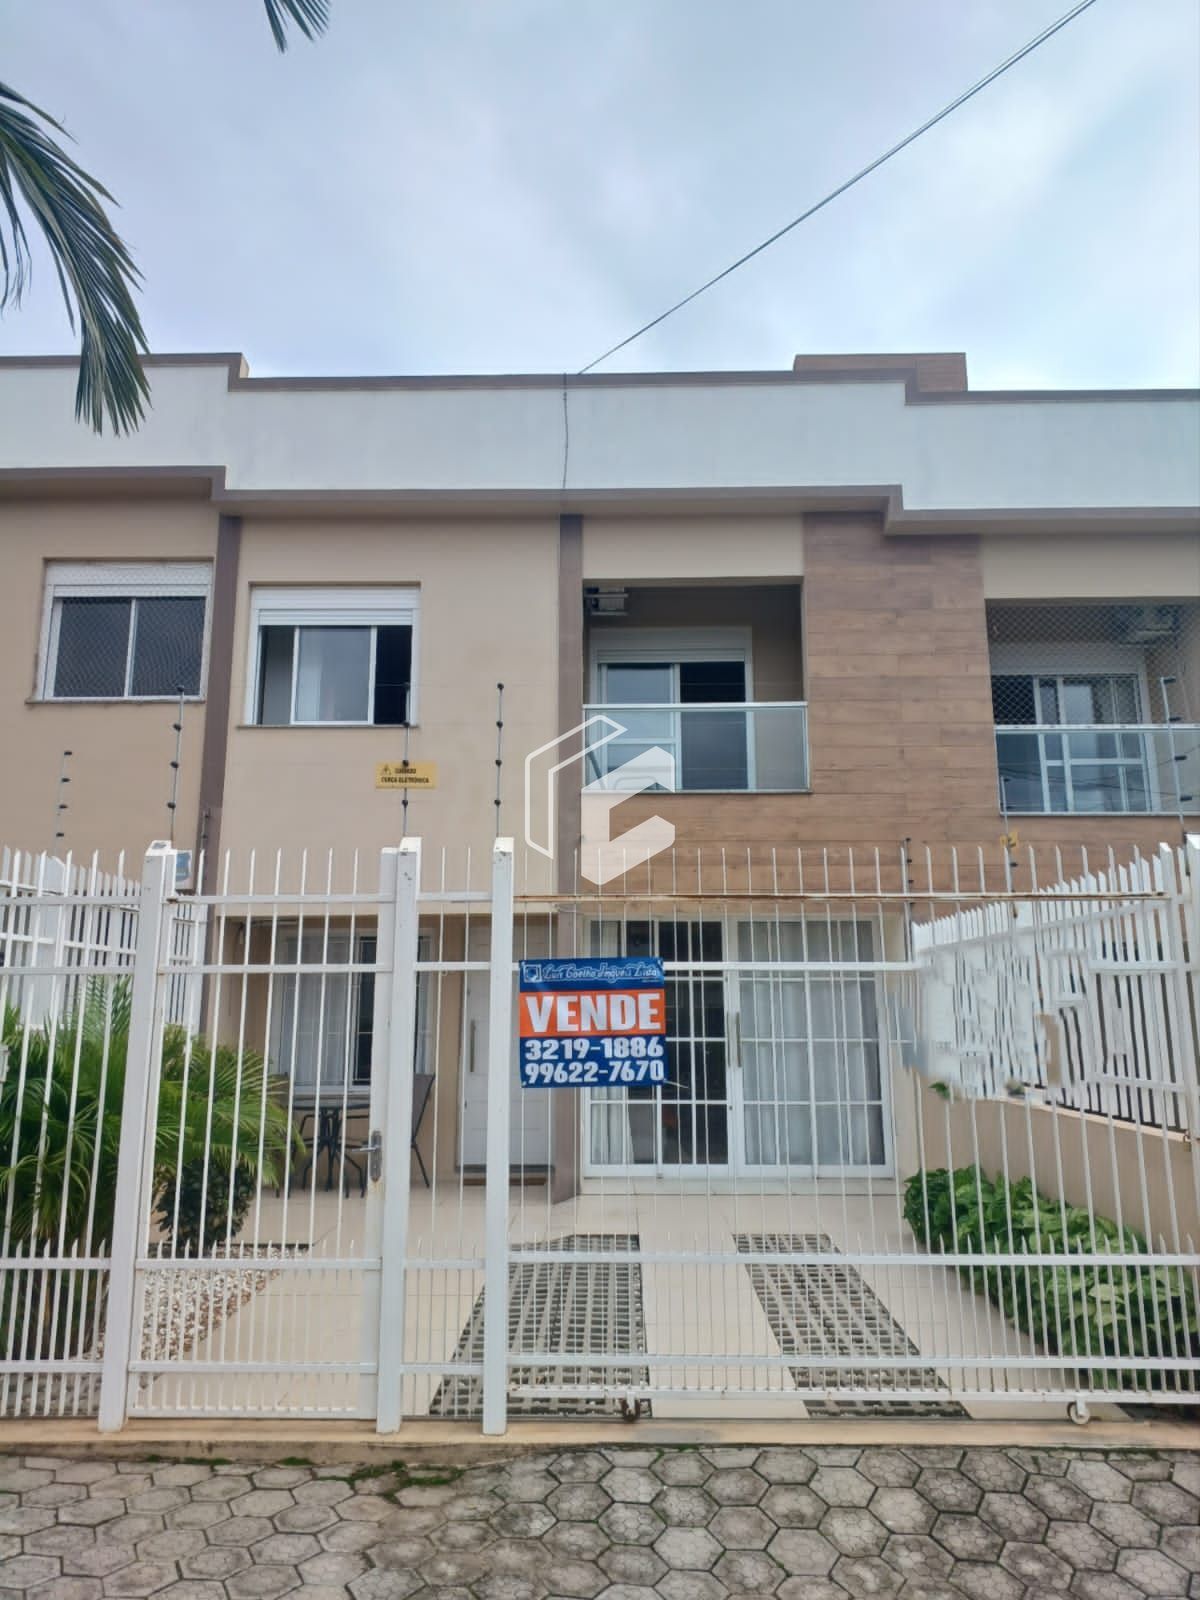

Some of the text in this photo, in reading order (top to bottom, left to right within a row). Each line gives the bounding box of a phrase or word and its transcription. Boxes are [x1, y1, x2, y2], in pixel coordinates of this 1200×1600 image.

[525, 993, 662, 1033] VENDE
[524, 1036, 664, 1061] 3219-1886
[524, 1060, 665, 1084] 99622-7670
